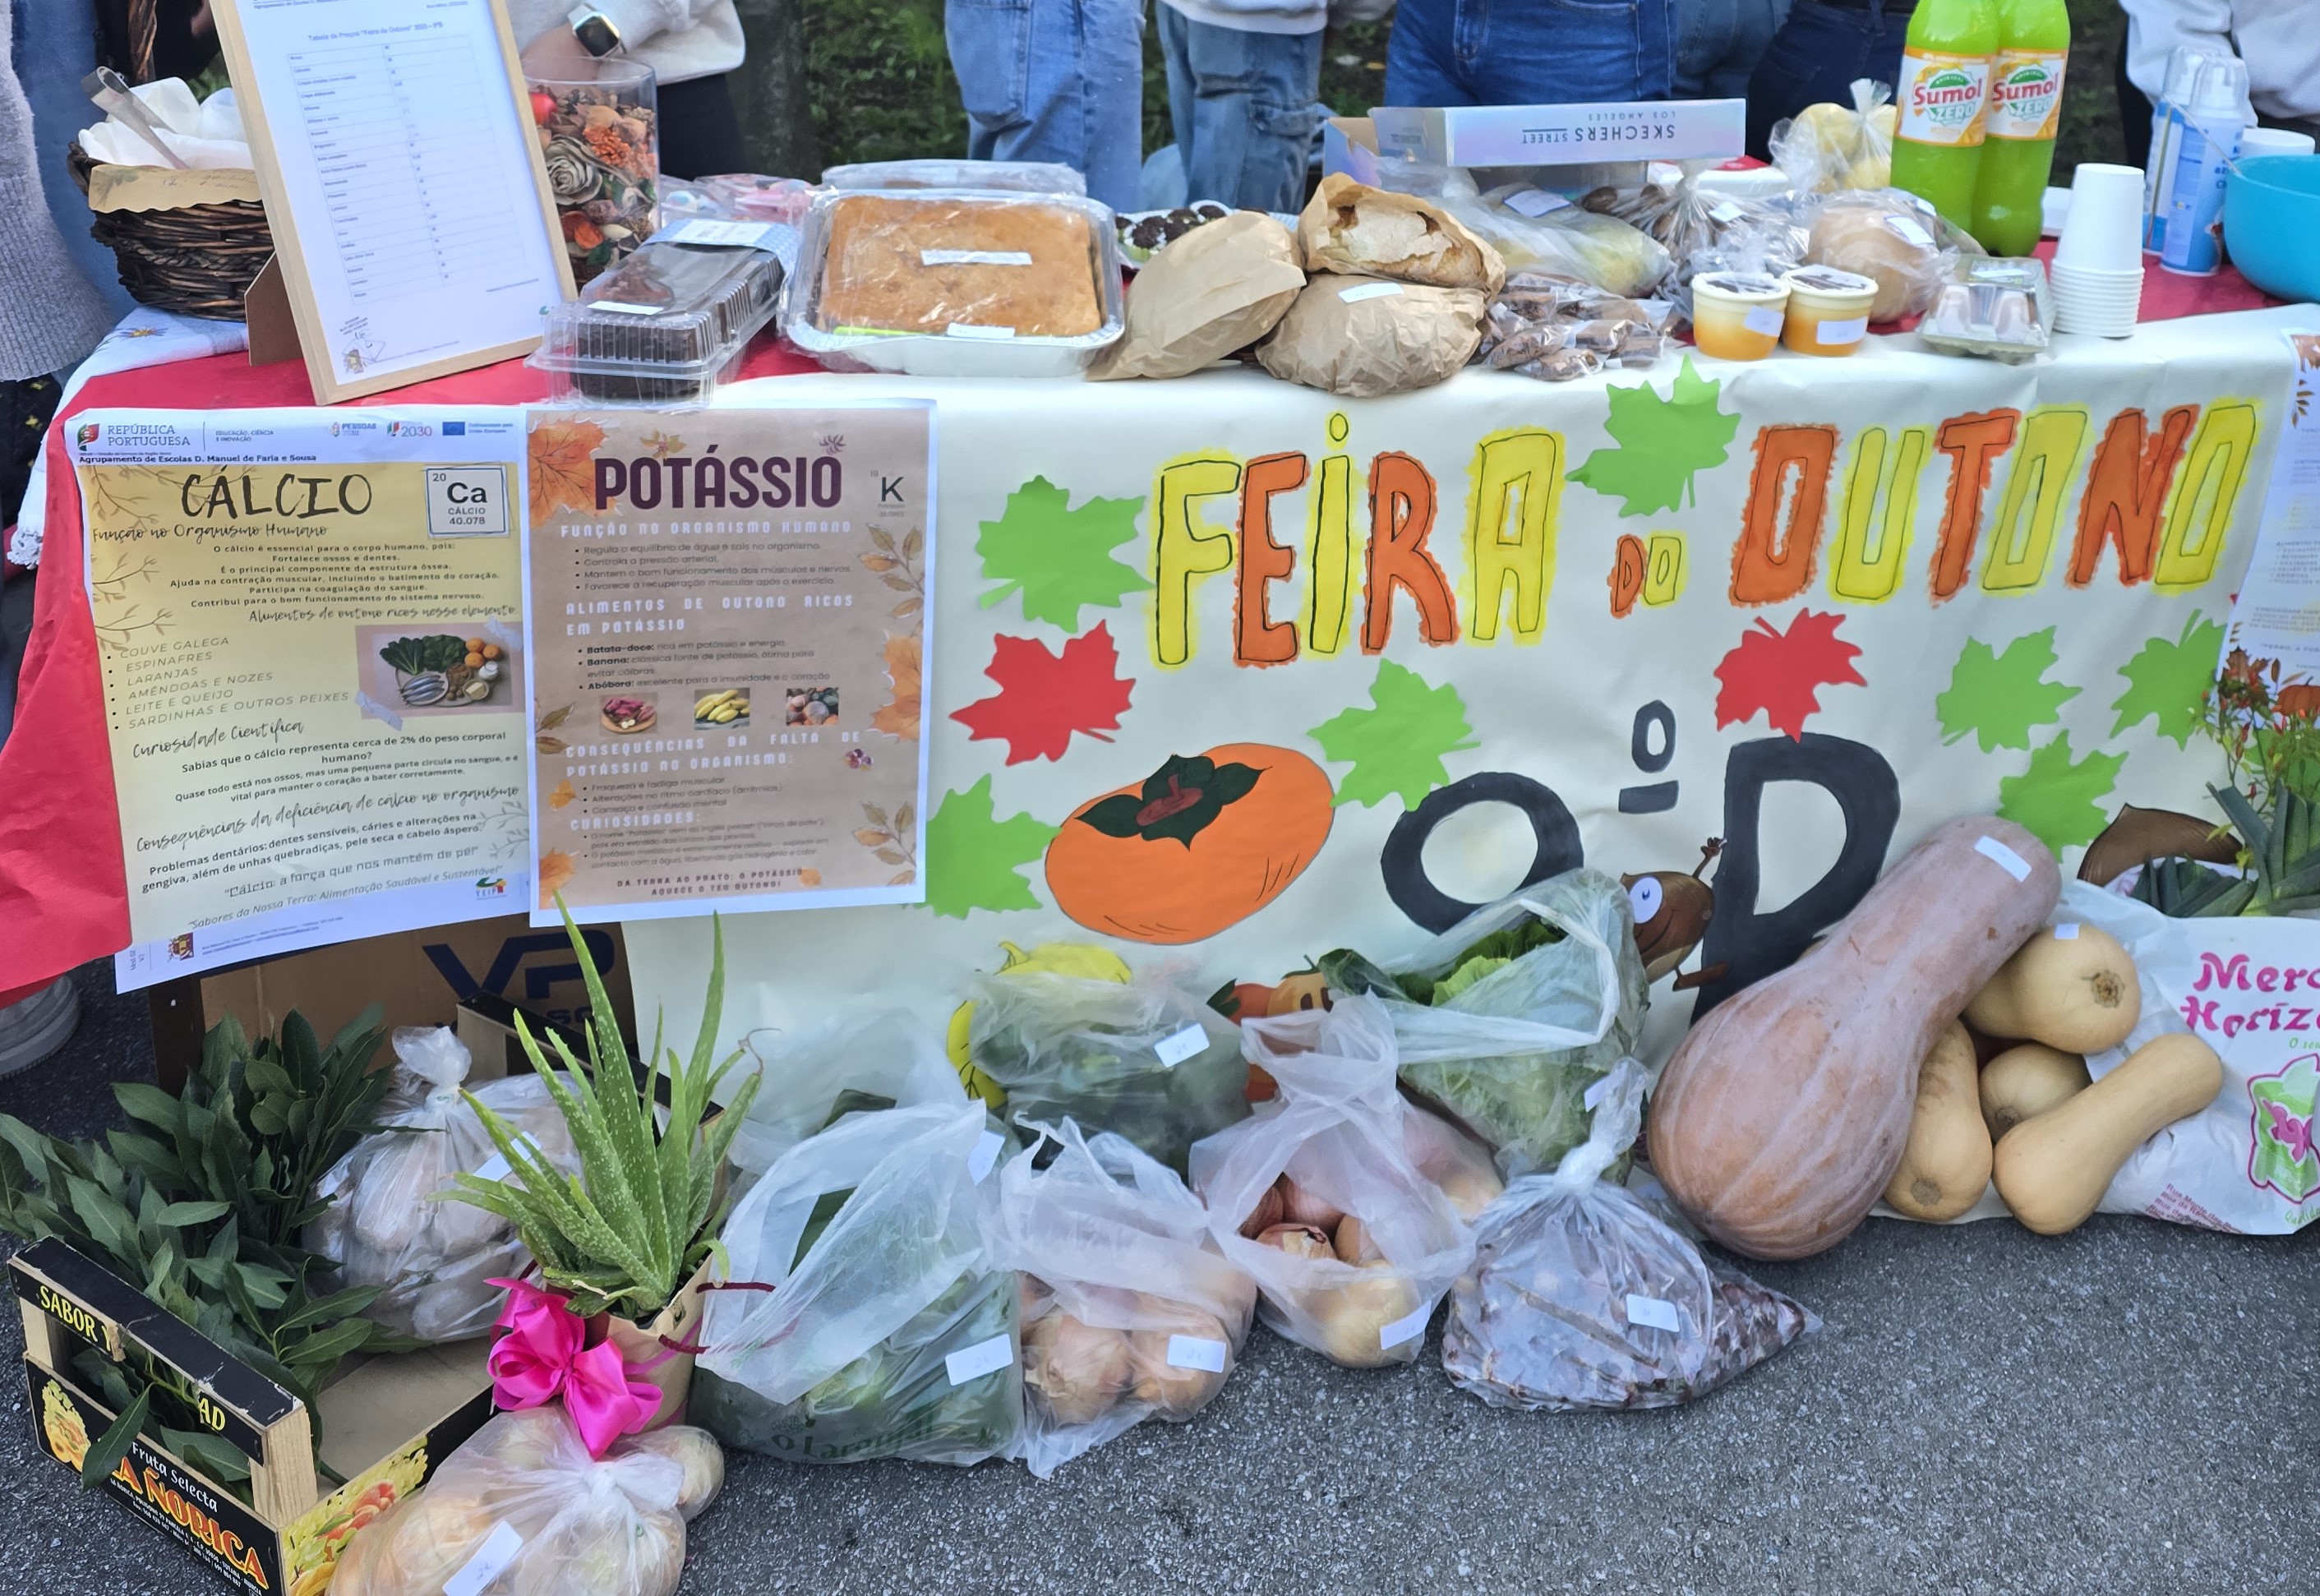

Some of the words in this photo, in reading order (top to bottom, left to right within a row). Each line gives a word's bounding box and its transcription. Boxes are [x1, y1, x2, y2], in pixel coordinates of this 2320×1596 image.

[1913, 78, 1983, 105] Sumol
[1993, 72, 2058, 101] Sumol
[1588, 112, 1643, 121] ANGELES
[1654, 111, 1676, 119] LOS
[1935, 104, 1973, 121] ZERO
[2015, 99, 2050, 117] ZERO
[1523, 133, 1568, 144] STREET
[1575, 124, 1675, 141] SKECHERS
[108, 424, 175, 435] REPÚBLICA
[401, 426, 431, 437] 2030
[108, 436, 191, 446] PORTUGUESA
[79, 455, 142, 464] Agrupamento
[289, 454, 316, 462] Sousa
[433, 473, 446, 482] 20
[594, 445, 842, 510] POTÁSSIO
[182, 464, 372, 519] CÁLCIO
[447, 482, 488, 504] Ca
[881, 477, 904, 502] K
[448, 507, 486, 515] CÁLCIO
[450, 517, 486, 525] 40.078
[561, 522, 627, 538] FUNÇÃO
[639, 523, 658, 534] NO
[671, 521, 771, 534] ORGANISMO
[782, 521, 851, 534] HUMANO
[93, 527, 144, 543] Função
[150, 527, 168, 538] no
[174, 524, 260, 544] Organismo
[265, 523, 328, 537] Humano
[1152, 411, 1561, 667] FEIRA
[1607, 532, 1686, 617] DO
[1730, 399, 2262, 607] OUTONO
[317, 546, 340, 554] para
[385, 543, 429, 551] humano,
[431, 543, 455, 551] pois:
[584, 546, 618, 556] Regula
[678, 543, 691, 551] de
[731, 542, 750, 551] sais
[768, 542, 820, 551] organismo.
[584, 558, 627, 566] Controla
[639, 556, 679, 566] pressão
[566, 599, 665, 615] ALIMENTOS
[685, 597, 703, 610] DE
[722, 596, 786, 609] OUTONO
[805, 594, 853, 607] RICOS
[567, 622, 590, 636] EM
[602, 618, 685, 634] POTÁSSIO
[120, 643, 168, 658] COUVE
[173, 637, 229, 651] GALEGA
[587, 644, 654, 654] Batata-doce:
[126, 651, 213, 672] ESPINAFRES
[587, 657, 630, 667] Banana:
[127, 667, 199, 687] LARANJAS
[128, 679, 208, 700] AMÊNDOAS
[214, 677, 221, 686] E
[227, 672, 274, 684] NOZES
[588, 680, 634, 690] Abóbora:
[126, 699, 162, 715] LEITE
[168, 698, 176, 707] E
[181, 689, 233, 706] QUEIJO
[128, 704, 214, 730] SARDINHAS
[219, 703, 228, 713] E
[233, 695, 293, 711] OUTROS
[299, 692, 349, 704] PEIXES
[133, 727, 227, 759] Curiosidade
[182, 759, 218, 773] Sabias
[220, 755, 241, 768] que
[254, 746, 286, 760] cálcio
[288, 740, 349, 756] representa
[352, 740, 381, 748] cerca
[384, 737, 398, 745] de
[400, 736, 416, 745] 2%
[418, 735, 432, 744] do
[435, 734, 459, 745] peso
[462, 731, 506, 742] corporal
[566, 738, 704, 758] CONSEQUÊNCIAS
[727, 736, 747, 747] DA
[770, 732, 819, 745] FALTA
[842, 731, 860, 743] DE
[321, 751, 372, 764] humano?
[567, 761, 649, 777] POTÁSSIO
[660, 759, 679, 772] NO
[149, 855, 210, 875] Problemas
[211, 842, 267, 861] dentários:
[268, 835, 305, 850] dentes
[307, 825, 359, 842] sensíveis,
[362, 820, 394, 832] cáries
[405, 814, 460, 827] alterações
[142, 874, 189, 894] gengiva,
[191, 866, 219, 880] além
[223, 863, 236, 874] de
[238, 856, 272, 869] unhas
[274, 842, 343, 862] quebradiças,
[345, 837, 368, 850] pele
[371, 833, 394, 844] seca
[406, 828, 440, 839] cabelo
[443, 824, 482, 836] áspero.
[39, 1285, 98, 1341] SABOR
[132, 1441, 168, 1477] Fruta
[171, 1469, 218, 1513] Selecta
